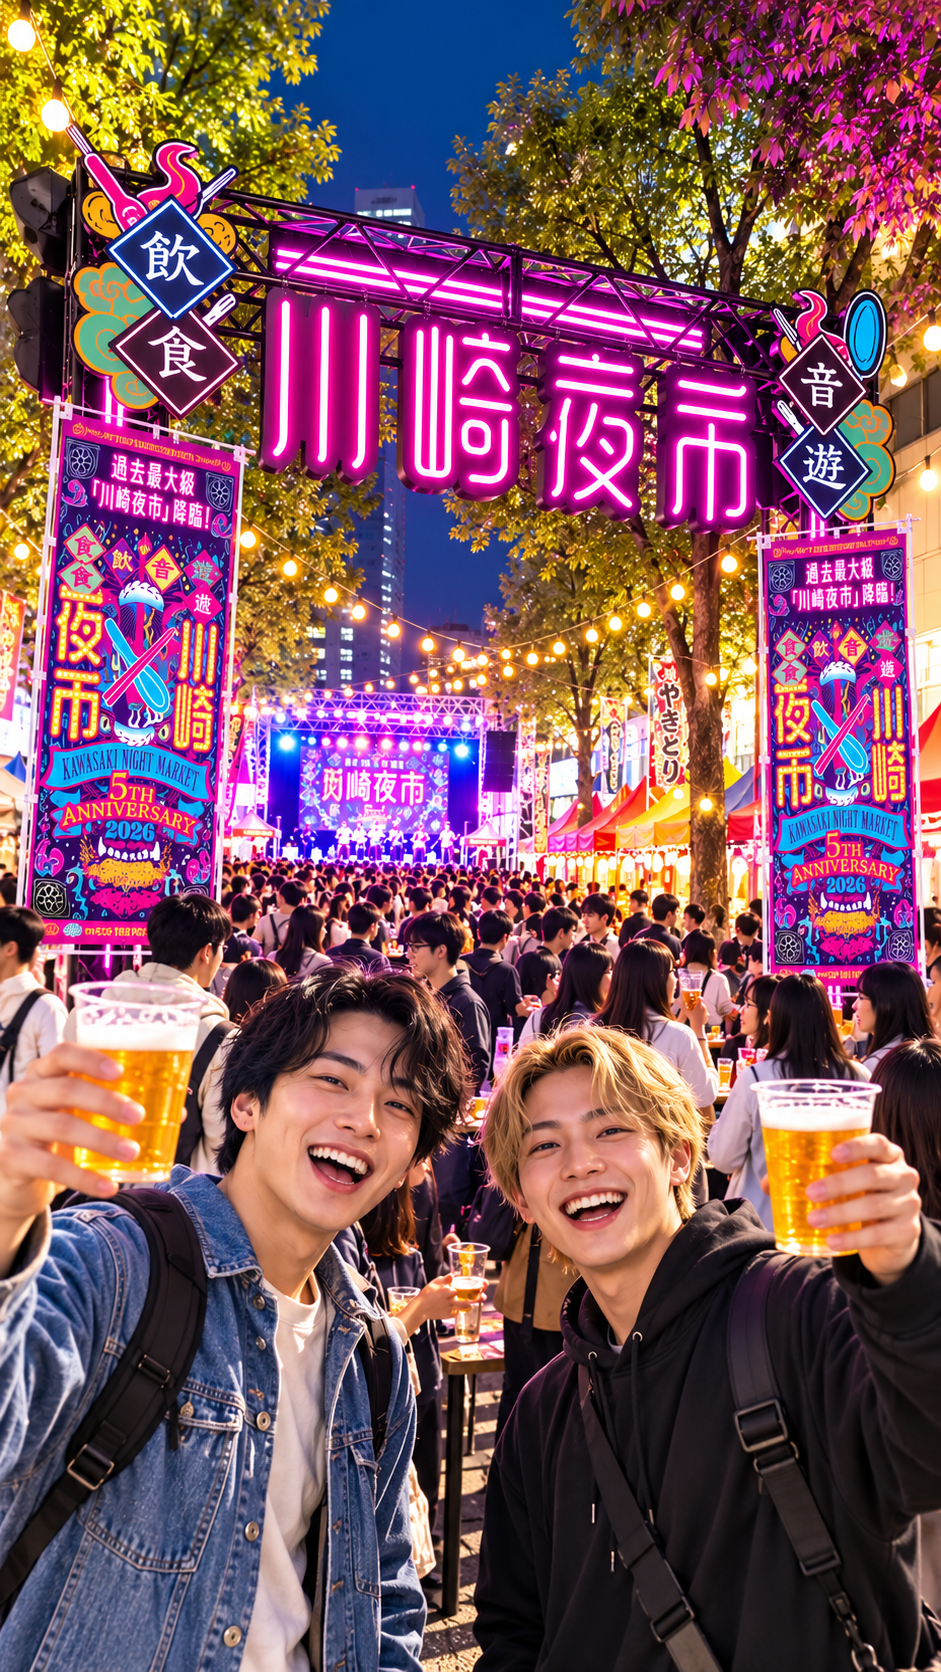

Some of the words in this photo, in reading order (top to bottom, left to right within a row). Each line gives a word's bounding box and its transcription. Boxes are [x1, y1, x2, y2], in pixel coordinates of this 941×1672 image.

[140, 230, 205, 286] 飲
[148, 325, 208, 382] 食
[801, 362, 843, 409] 音
[272, 299, 748, 522] 川崎夜市
[111, 454, 195, 497] 過去最大級
[802, 443, 846, 490] 遊
[151, 557, 174, 580] 音
[51, 583, 104, 742] 夜市
[843, 636, 862, 656] 音
[173, 618, 219, 753] 川崎
[658, 682, 680, 783] やきとり
[774, 678, 815, 810] 夜市
[872, 685, 906, 803] 川崎
[62, 749, 118, 780] KAWASAKI
[122, 749, 154, 772] NIGHT
[155, 755, 200, 791] MARKET
[110, 772, 154, 803] 5TH
[62, 801, 197, 834] ANNIVERSARY
[105, 820, 155, 841] 2026
[833, 810, 858, 829] NIGHT
[861, 810, 899, 841] MARKET
[826, 832, 862, 858] 5TH
[793, 858, 899, 882] ANNIVERSARY
[826, 876, 866, 894] 2026
